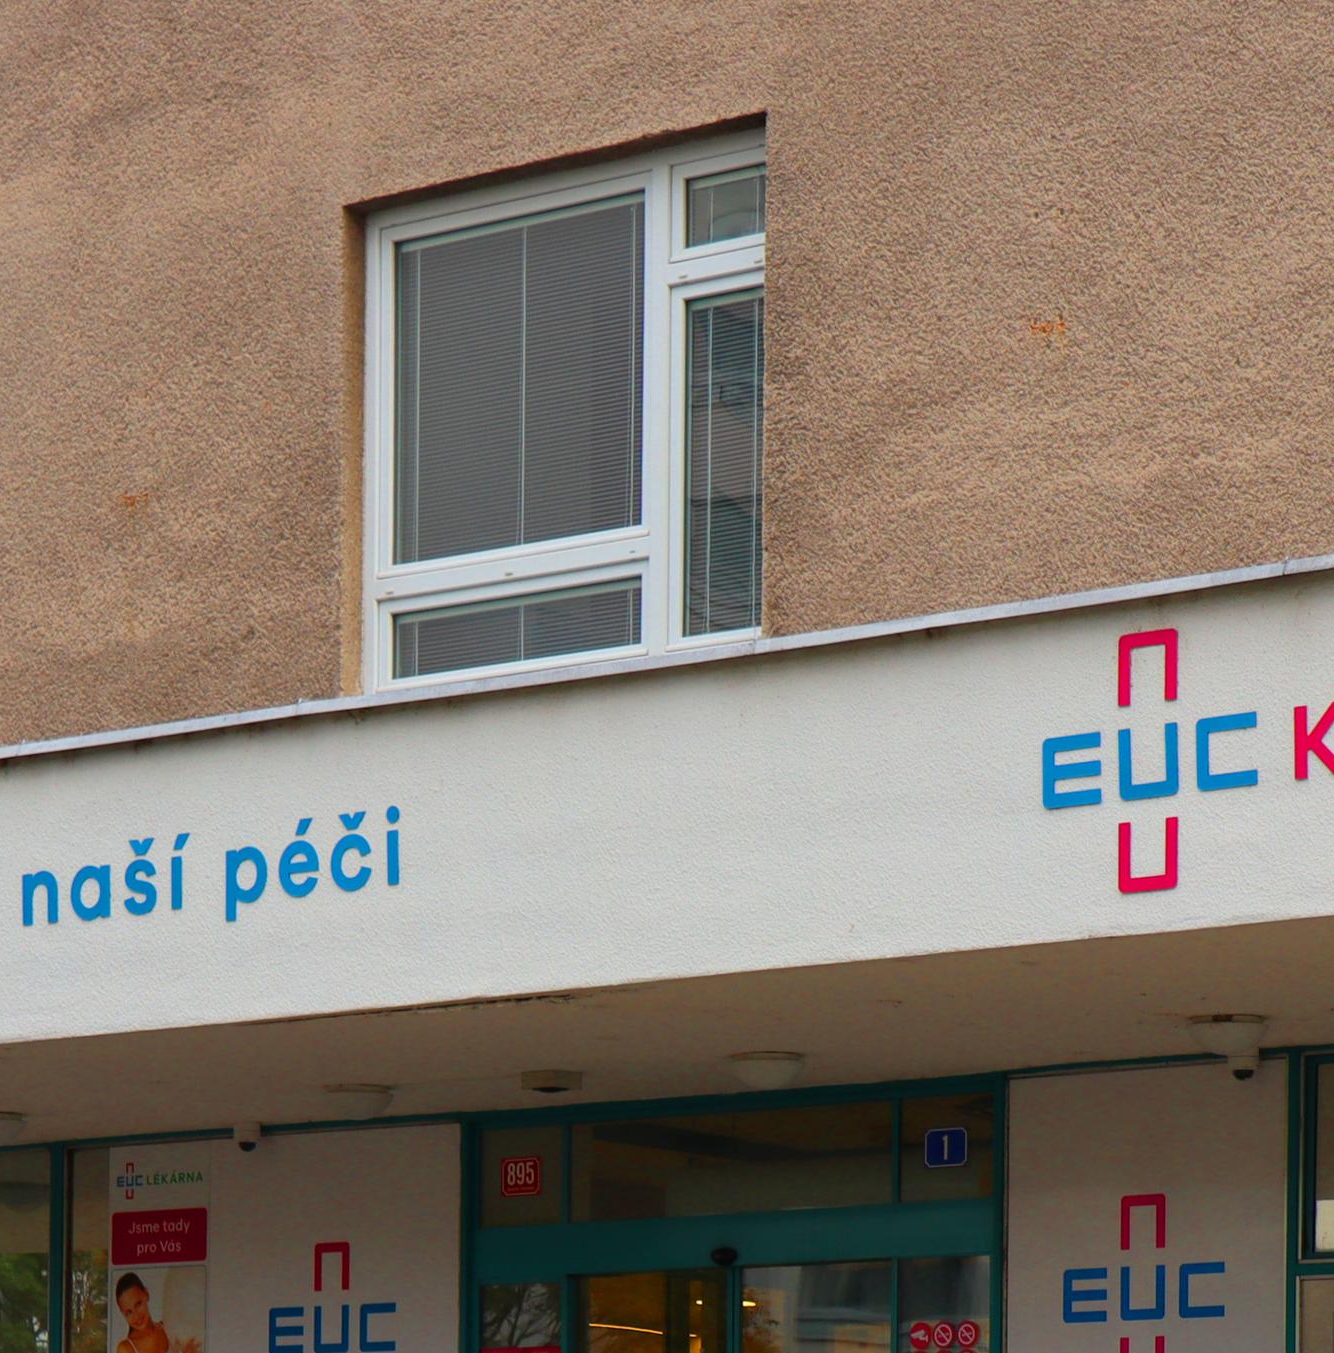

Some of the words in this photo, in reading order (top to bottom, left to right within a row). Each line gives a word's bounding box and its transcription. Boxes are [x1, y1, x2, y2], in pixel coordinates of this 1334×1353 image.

[1042, 711, 1258, 810] EUC
[22, 833, 190, 926] naší
[225, 805, 400, 921] péči
[941, 1135, 948, 1160] 1
[116, 1175, 143, 1188] EUC
[507, 1161, 535, 1186] 895
[128, 1221, 160, 1234] Jsme
[163, 1219, 191, 1234] tady
[137, 1242, 157, 1257] pro
[159, 1239, 181, 1253] Vás
[1062, 1261, 1225, 1323] EUC
